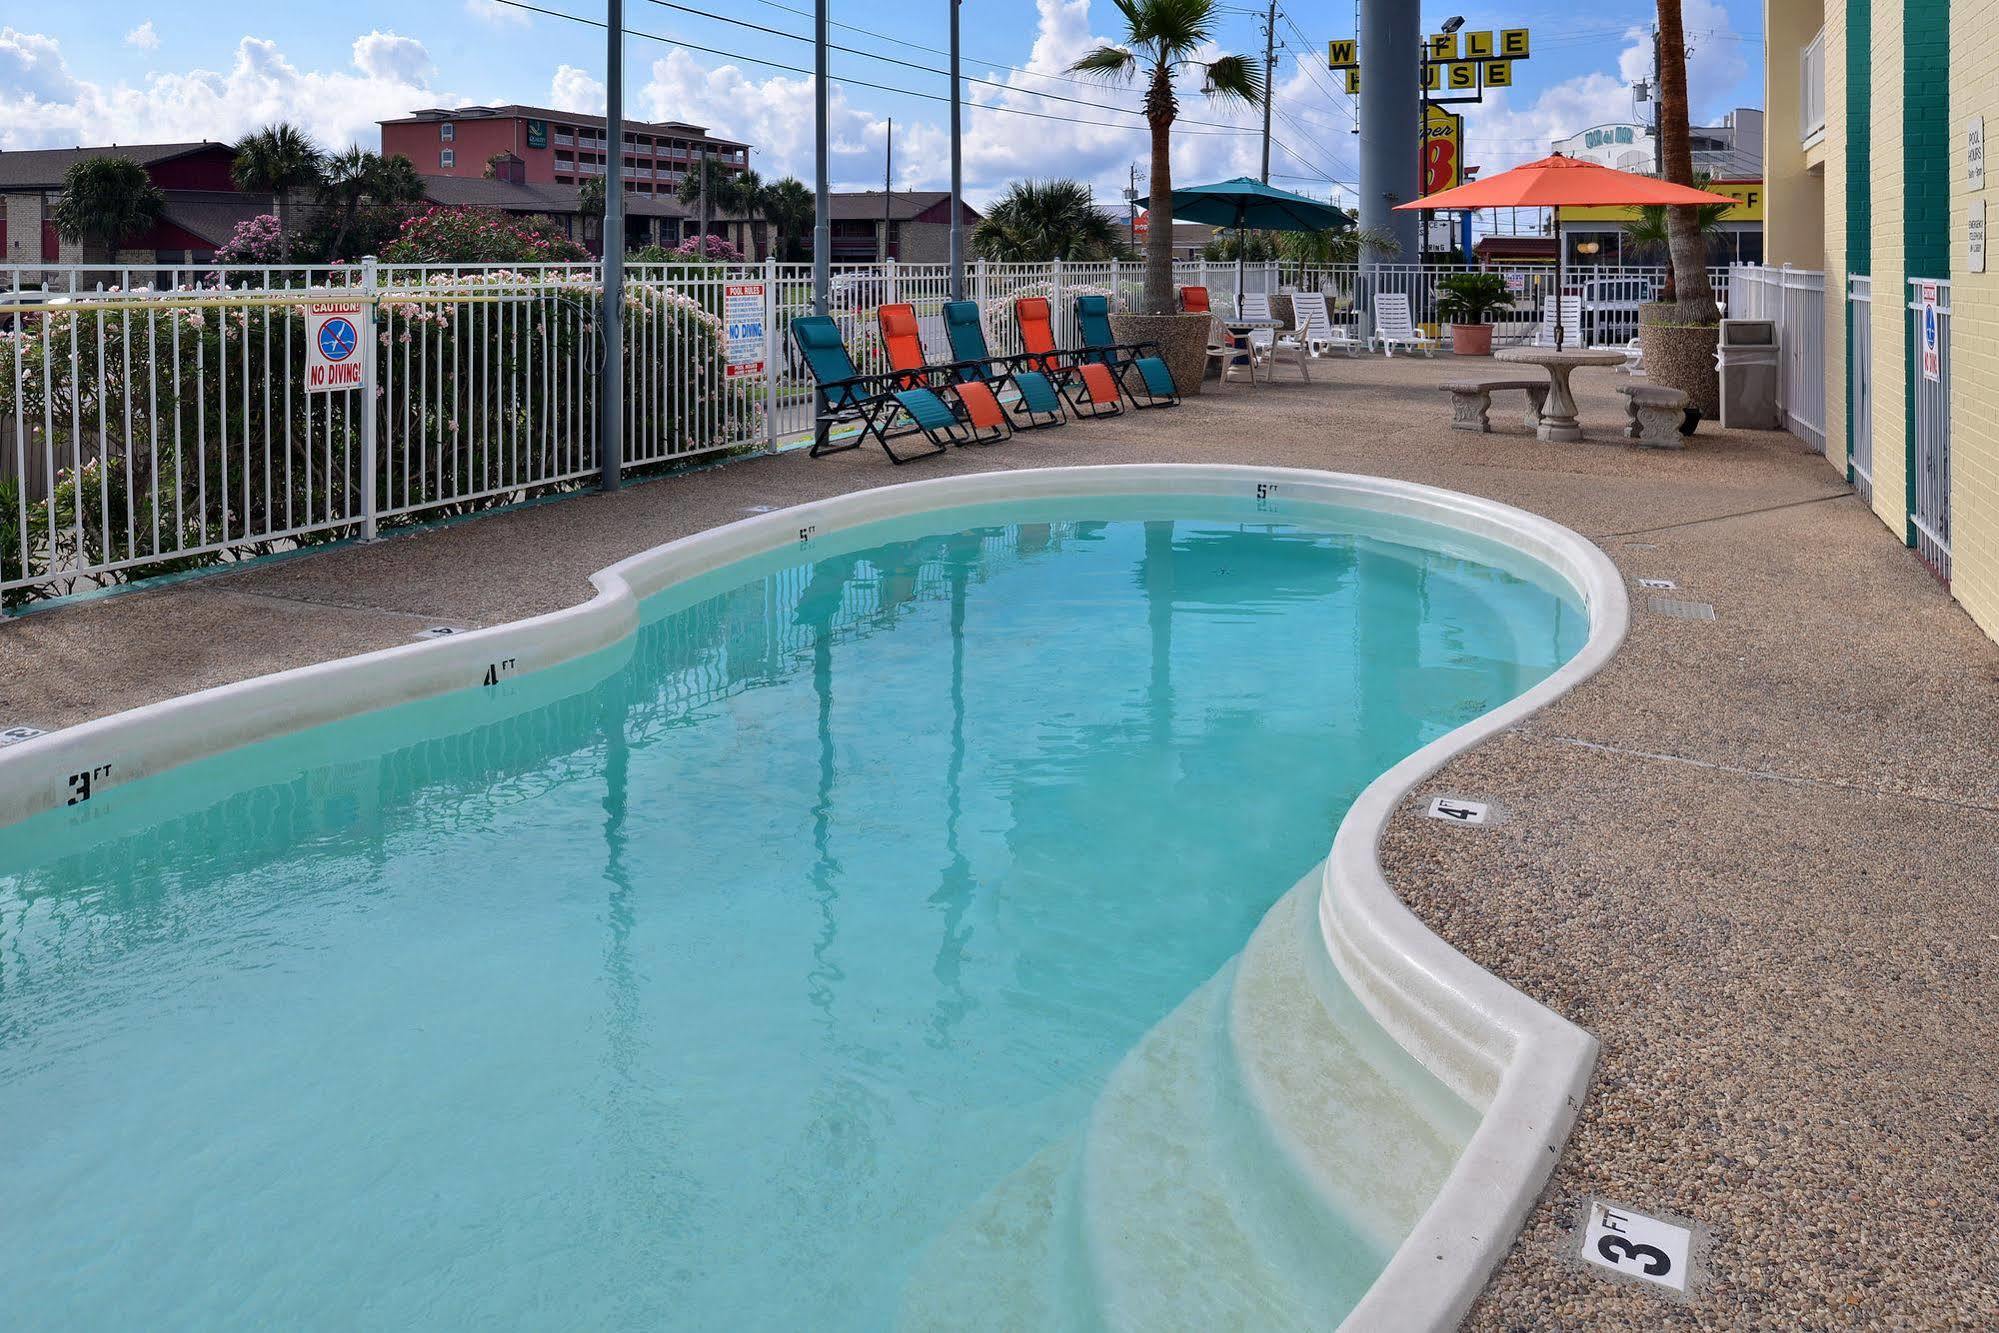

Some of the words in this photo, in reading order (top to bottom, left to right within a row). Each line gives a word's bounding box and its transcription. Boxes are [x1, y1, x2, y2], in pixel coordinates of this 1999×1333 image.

[1332, 32, 1523, 62] WFLE
[1351, 65, 1505, 91] HUSE
[730, 287, 743, 296] POOL
[745, 286, 760, 295] RULES
[312, 302, 360, 313] CAUTION!
[729, 324, 740, 339] NO
[311, 365, 325, 386] NO
[328, 362, 361, 384] DIVING!
[1257, 484, 1266, 499] 5
[483, 663, 499, 687] 4
[502, 658, 516, 671] FT
[67, 771, 91, 807] 3
[93, 763, 112, 781] FT
[1437, 806, 1478, 820] 4
[1601, 1208, 1629, 1234] FT
[1597, 1234, 1672, 1277] 3
